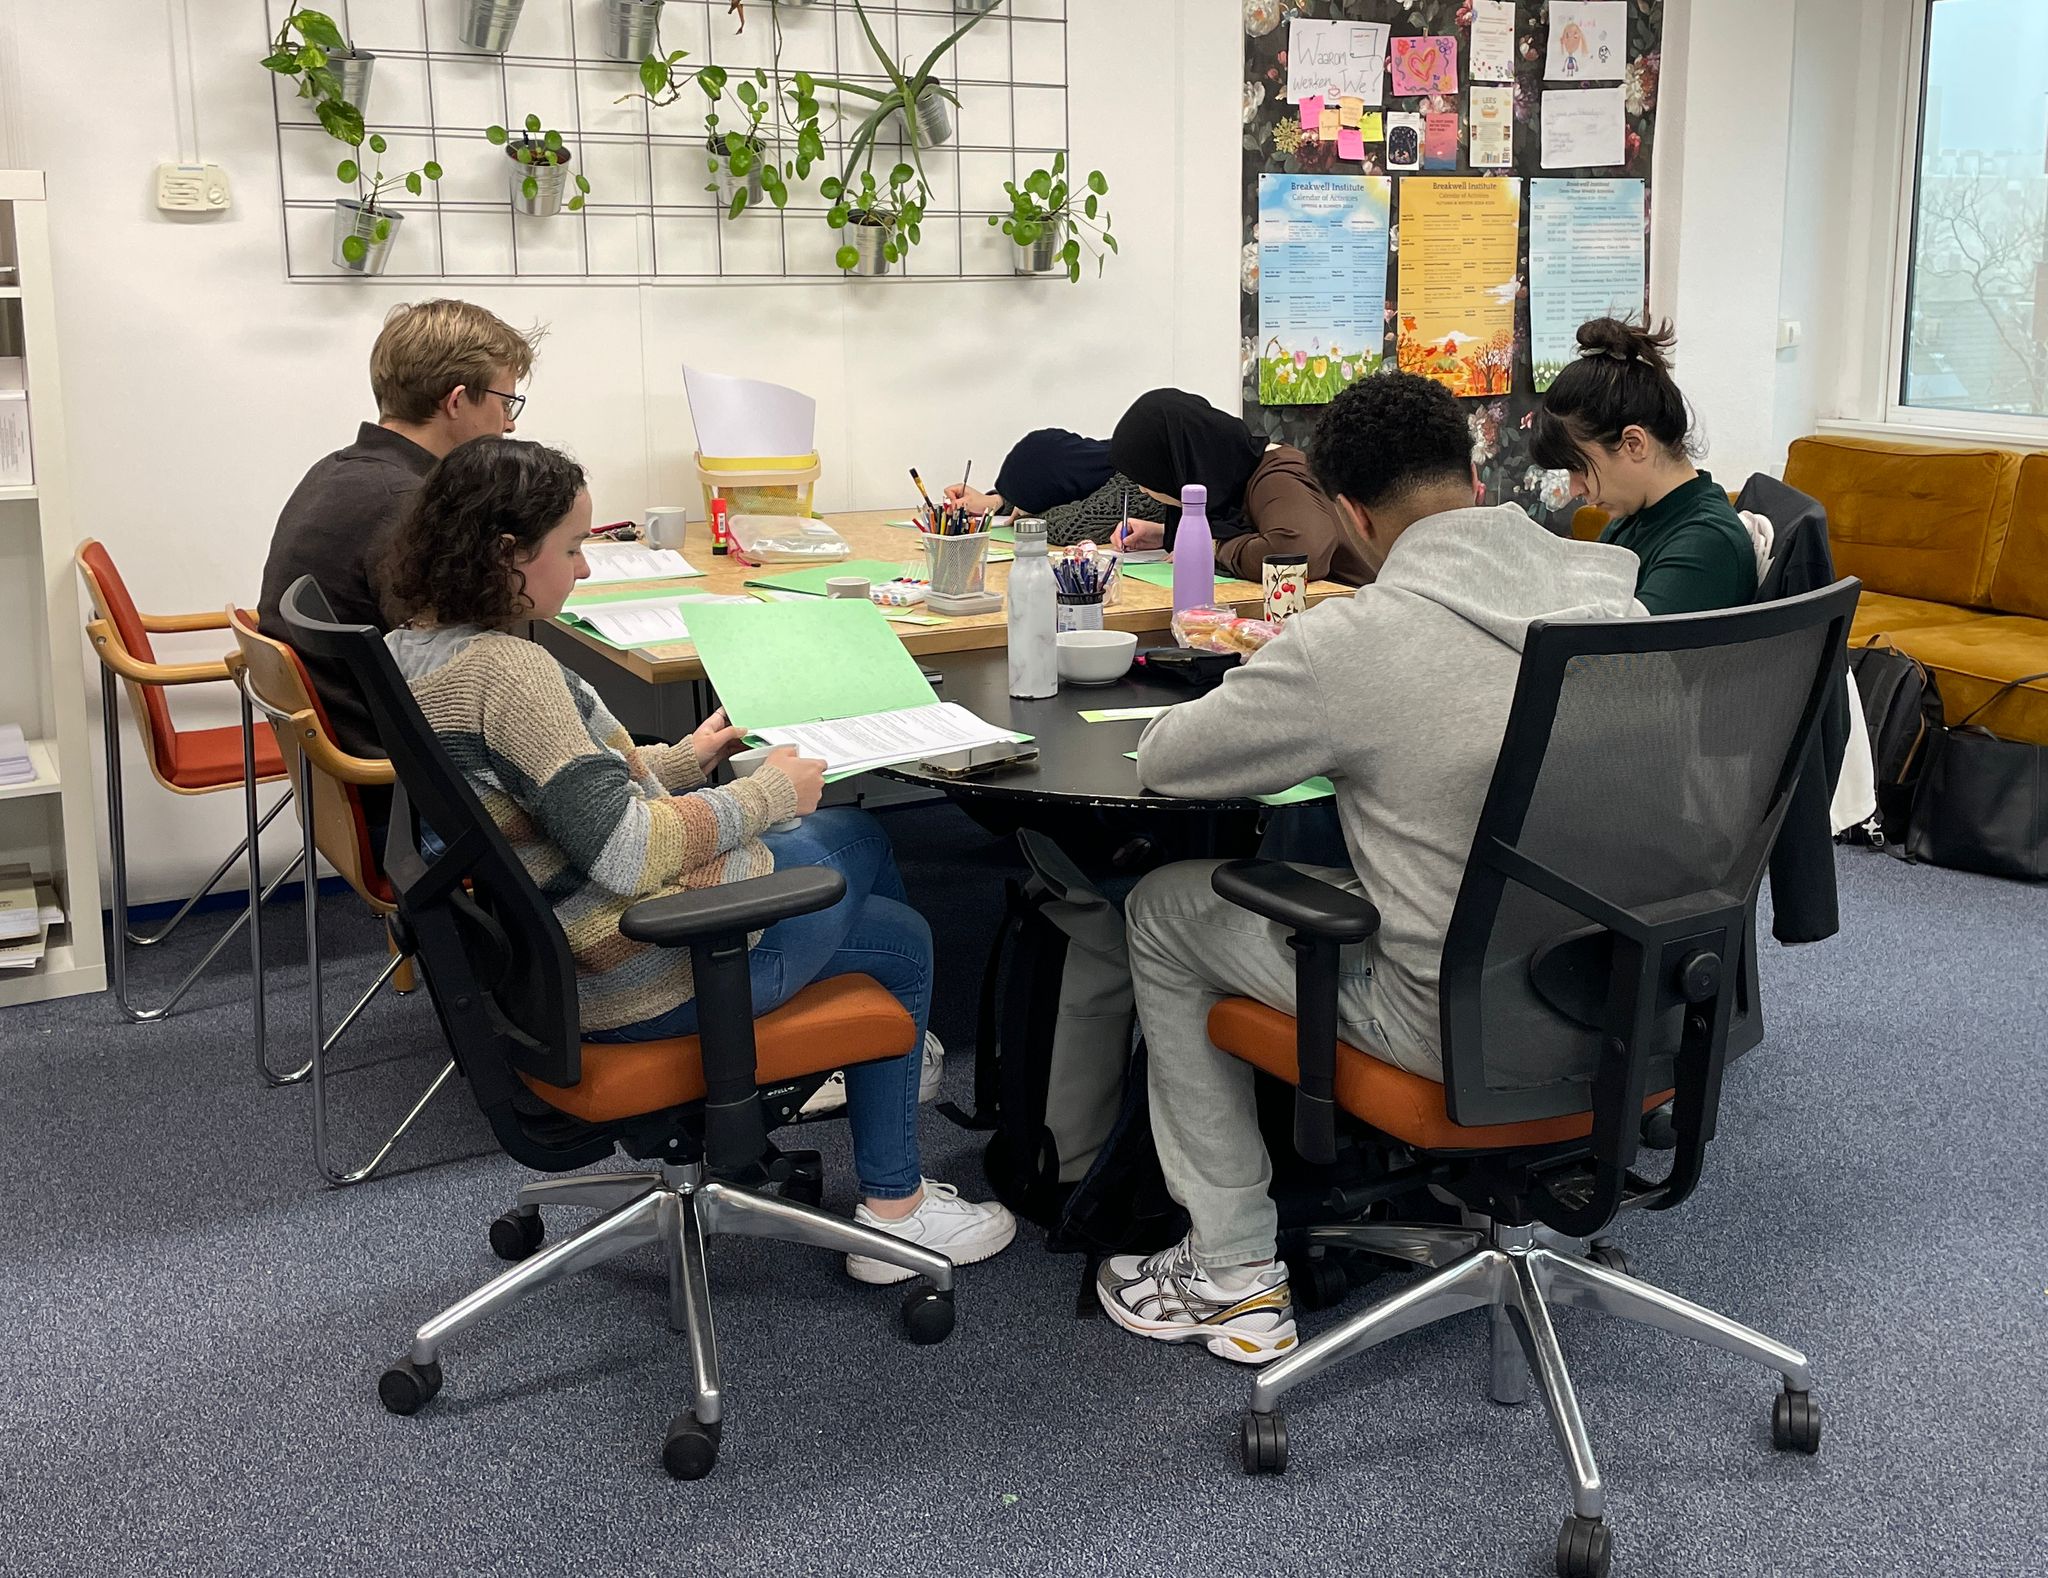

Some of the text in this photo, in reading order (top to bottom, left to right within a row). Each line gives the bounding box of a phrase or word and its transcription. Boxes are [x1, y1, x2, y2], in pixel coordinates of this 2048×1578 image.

[1291, 181, 1365, 192] Breakwell Institute
[1433, 181, 1497, 190] Breakwell Institute
[1292, 193, 1320, 201] Calendar
[1321, 193, 1329, 201] of
